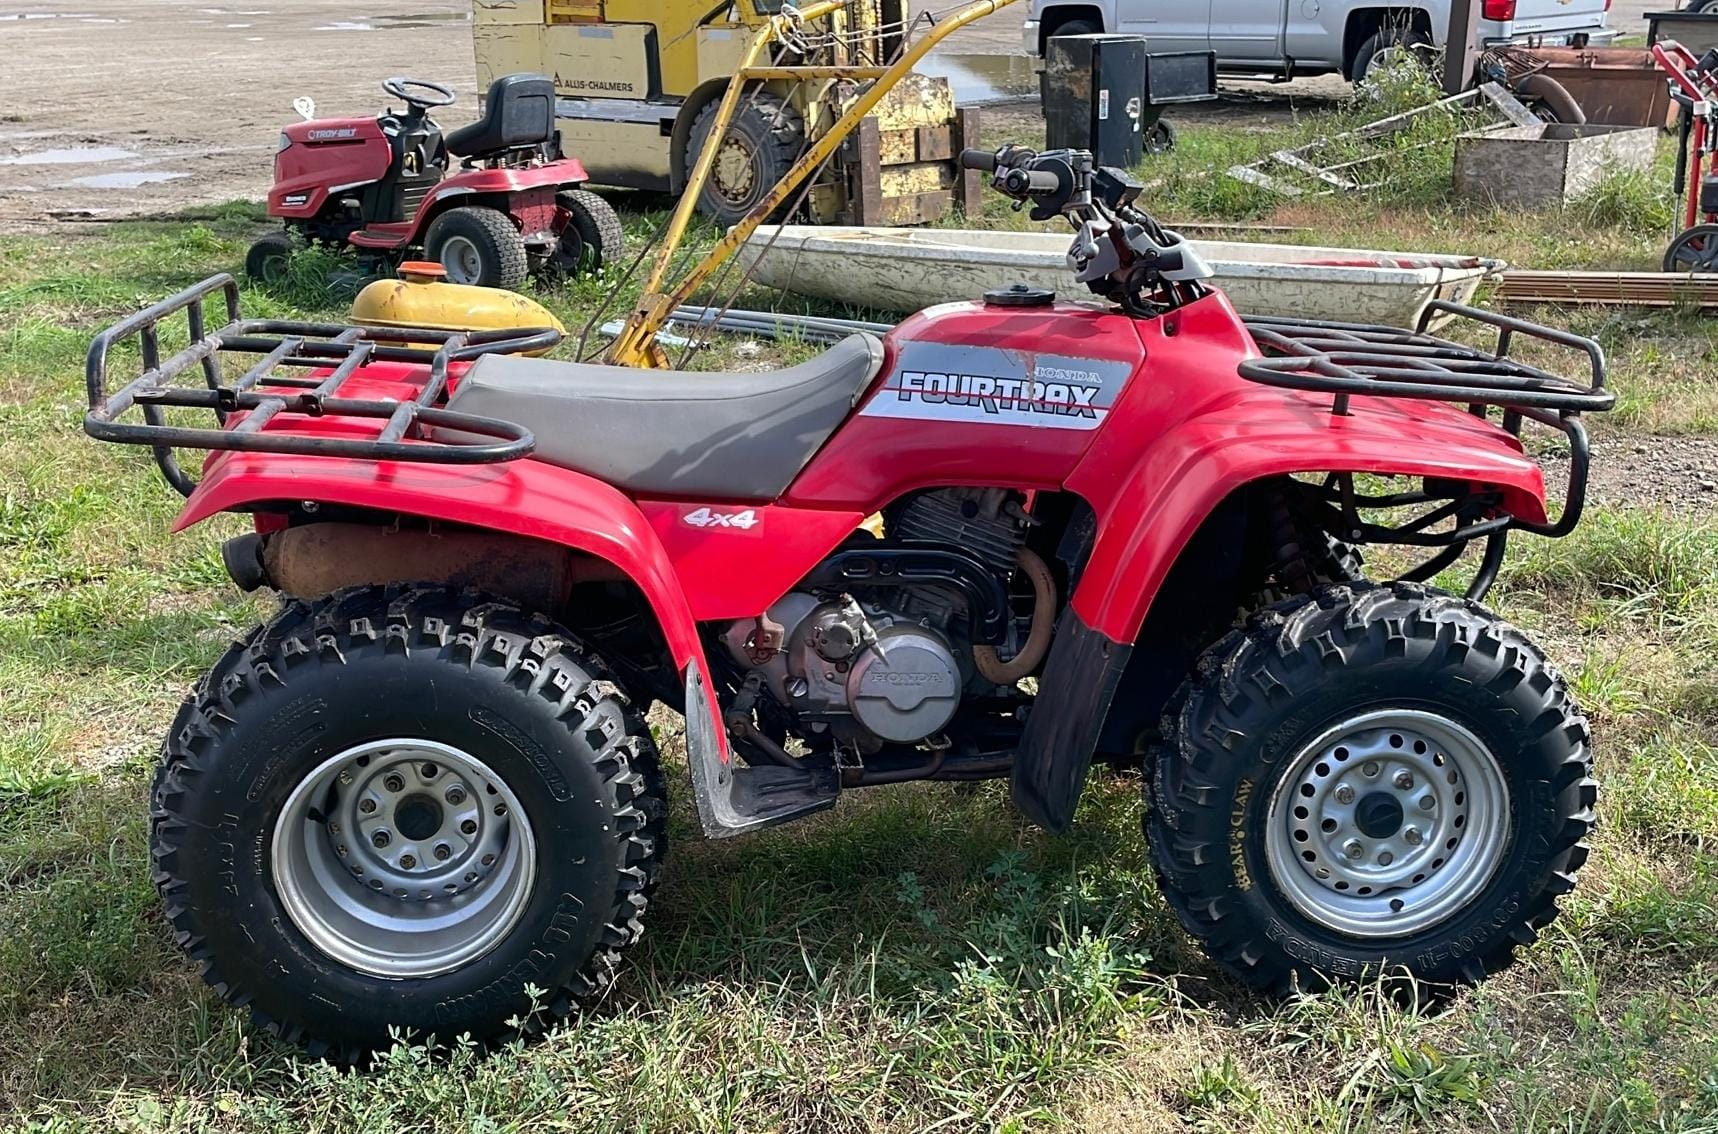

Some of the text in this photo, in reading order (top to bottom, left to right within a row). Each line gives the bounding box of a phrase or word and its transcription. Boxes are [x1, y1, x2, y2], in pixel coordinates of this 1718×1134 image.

[564, 80, 633, 92] ALLIS-CHALMERS
[315, 128, 357, 139] TROY-BILT
[898, 370, 1100, 419] FOURTRAX
[871, 670, 944, 684] HONDA
[1230, 779, 1254, 891] BEAR CLAW
